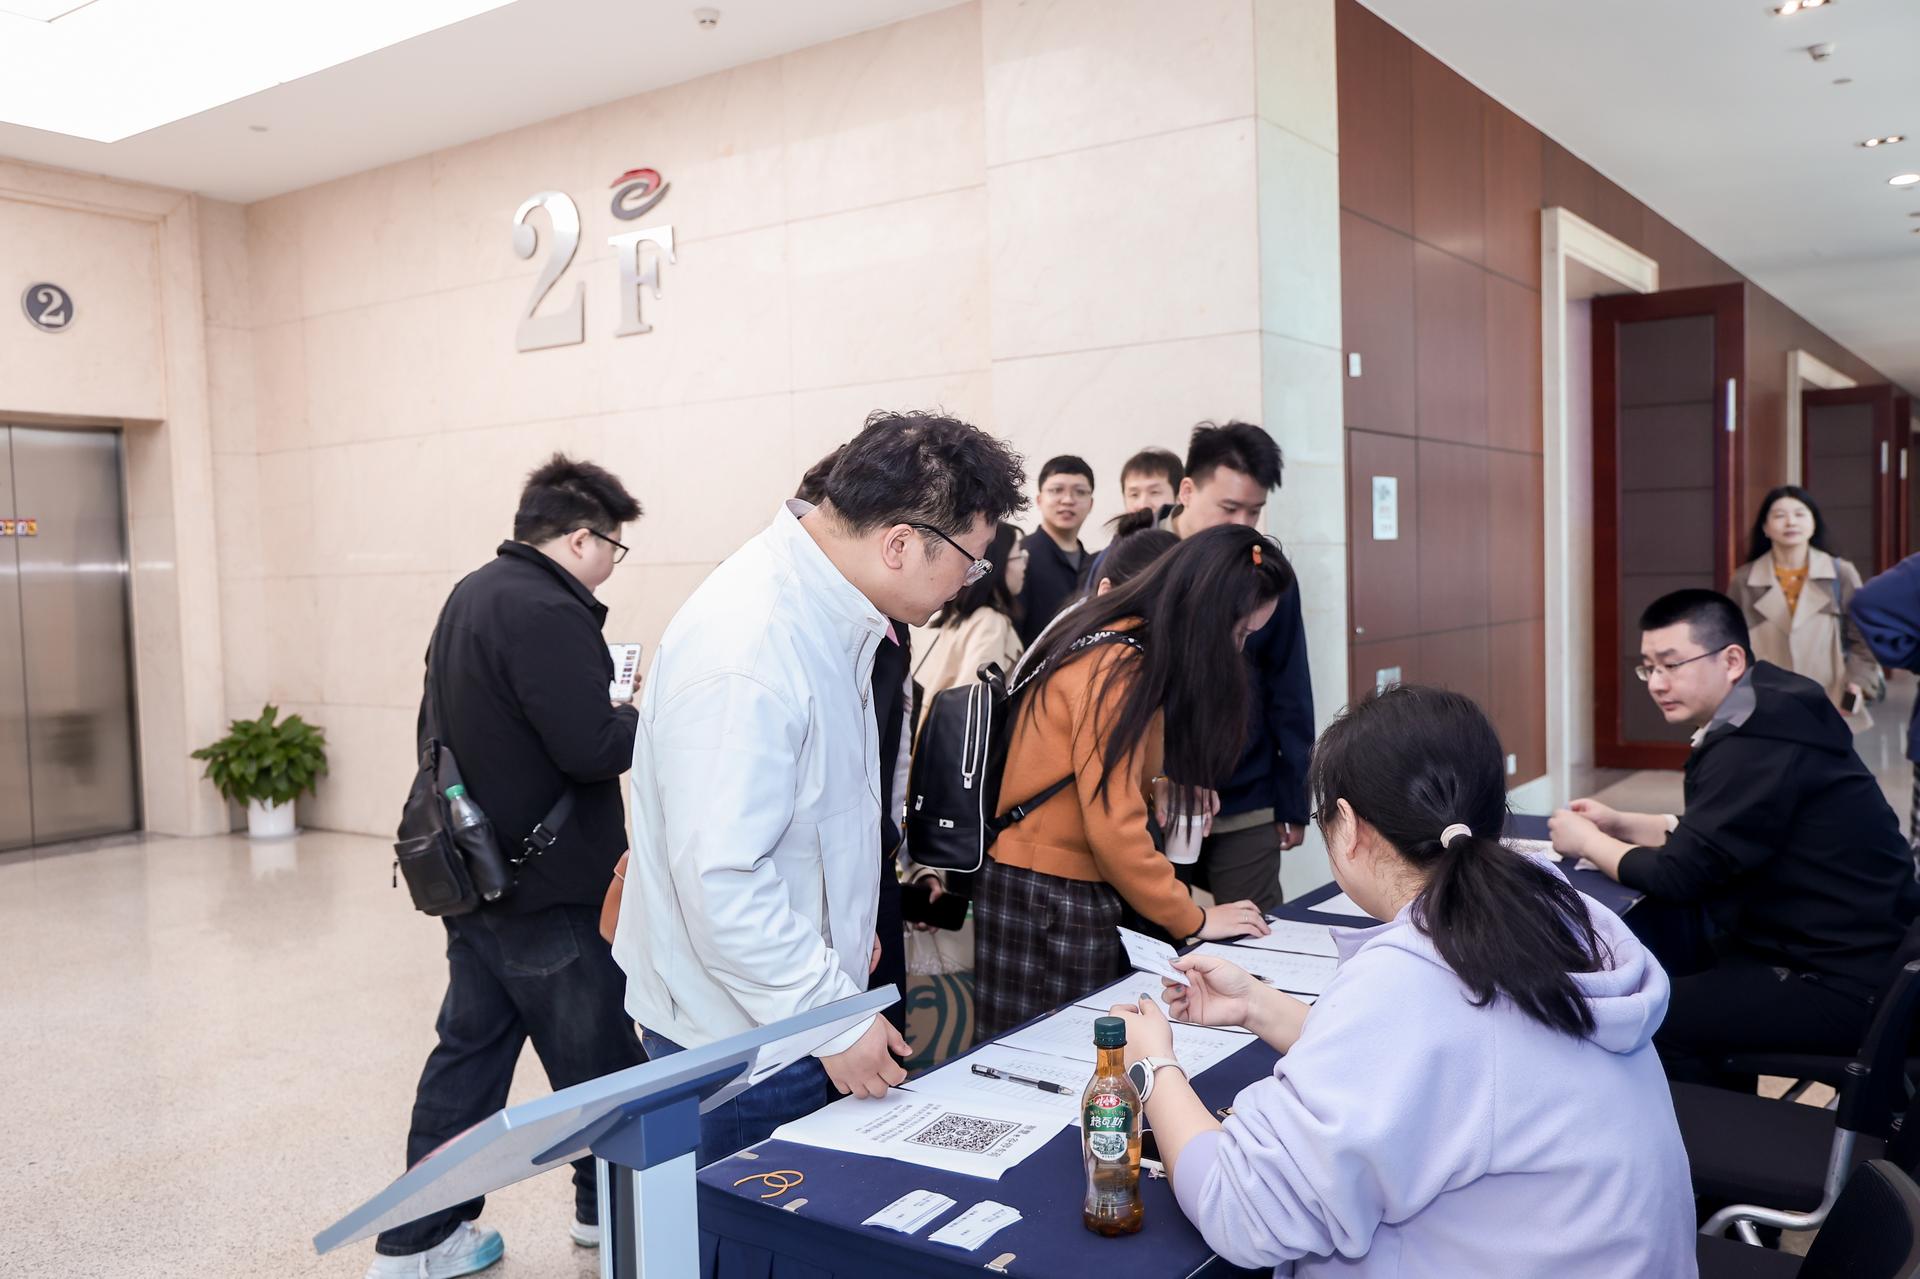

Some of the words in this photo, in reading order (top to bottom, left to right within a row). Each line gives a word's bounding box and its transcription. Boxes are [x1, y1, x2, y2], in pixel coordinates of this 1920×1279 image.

[512, 190, 677, 353] 2F
[37, 287, 65, 325] 2
[1090, 1115, 1125, 1128] 格瓦斯
